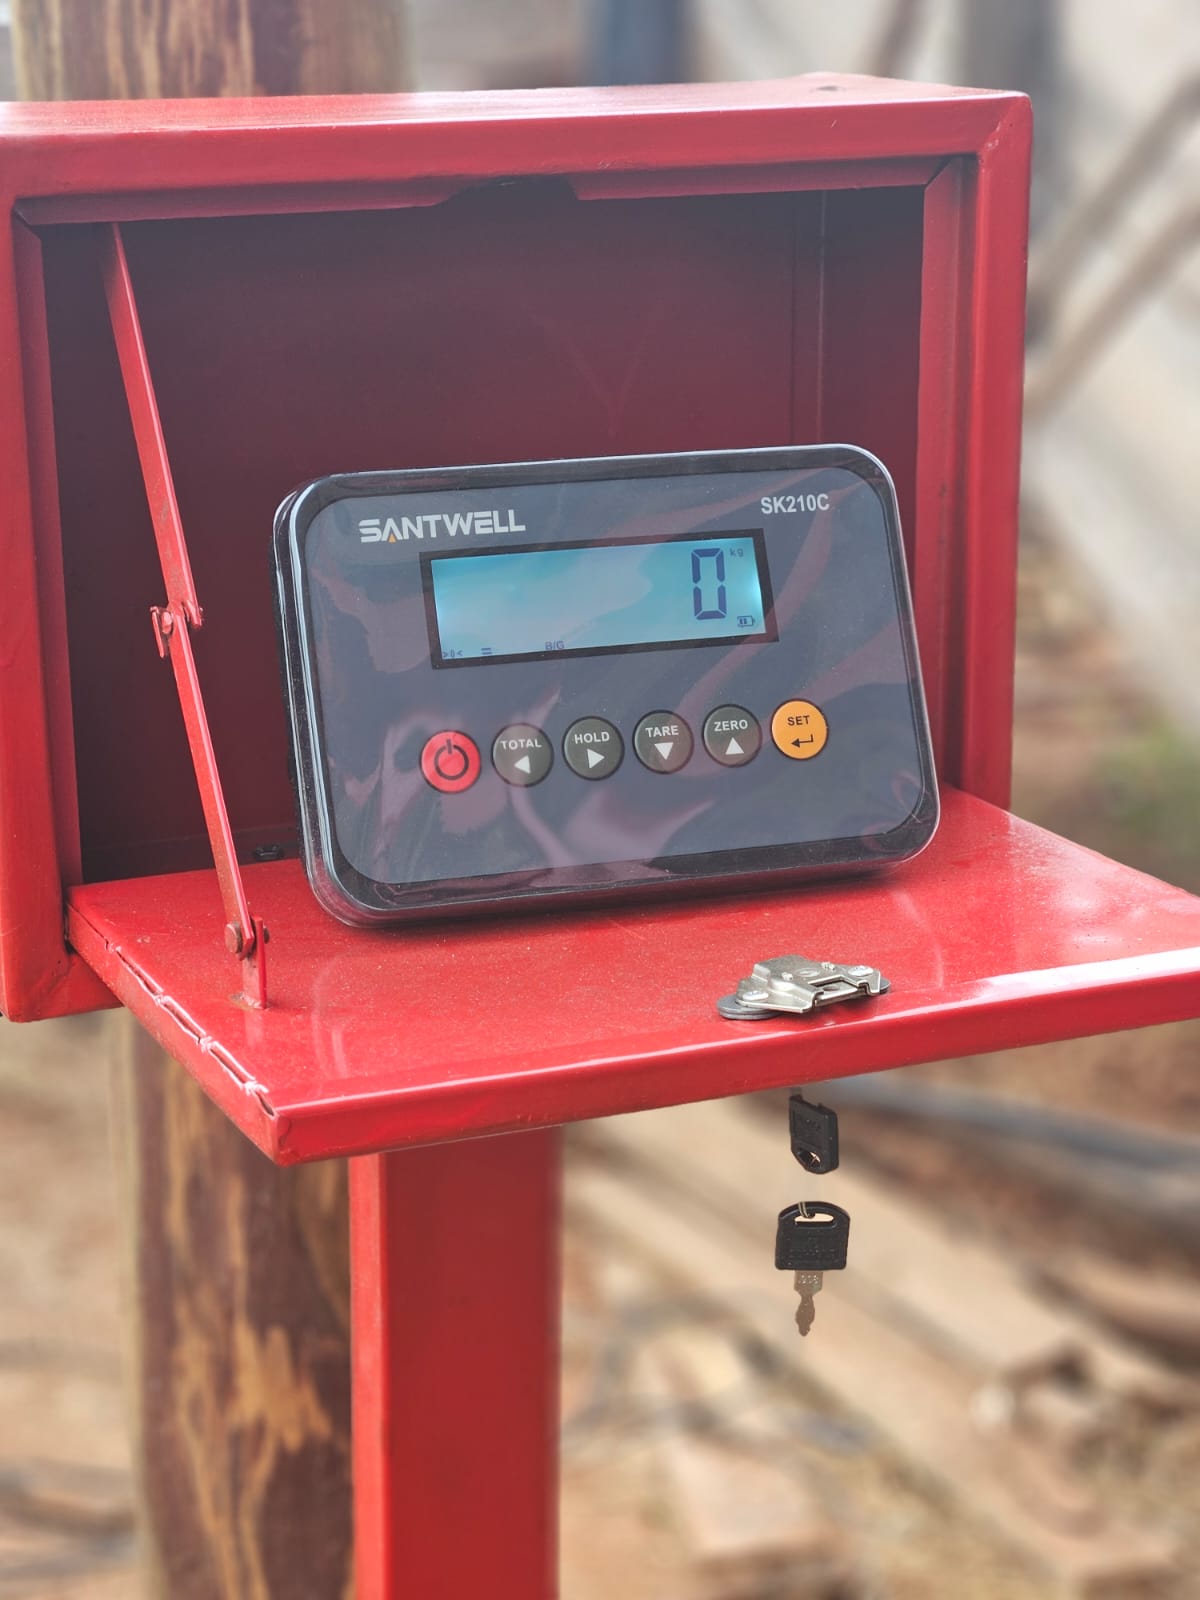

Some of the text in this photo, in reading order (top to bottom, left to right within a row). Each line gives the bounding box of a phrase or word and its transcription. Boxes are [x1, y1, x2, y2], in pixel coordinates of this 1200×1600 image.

[760, 493, 830, 514] SK210C
[358, 509, 526, 543] SANTWELL
[691, 548, 744, 620] 0 kg
[714, 719, 749, 732] ZERO
[787, 715, 811, 726] SET
[574, 731, 610, 744] HOLD
[645, 725, 680, 738] TARE
[500, 738, 542, 750] TOTAL
